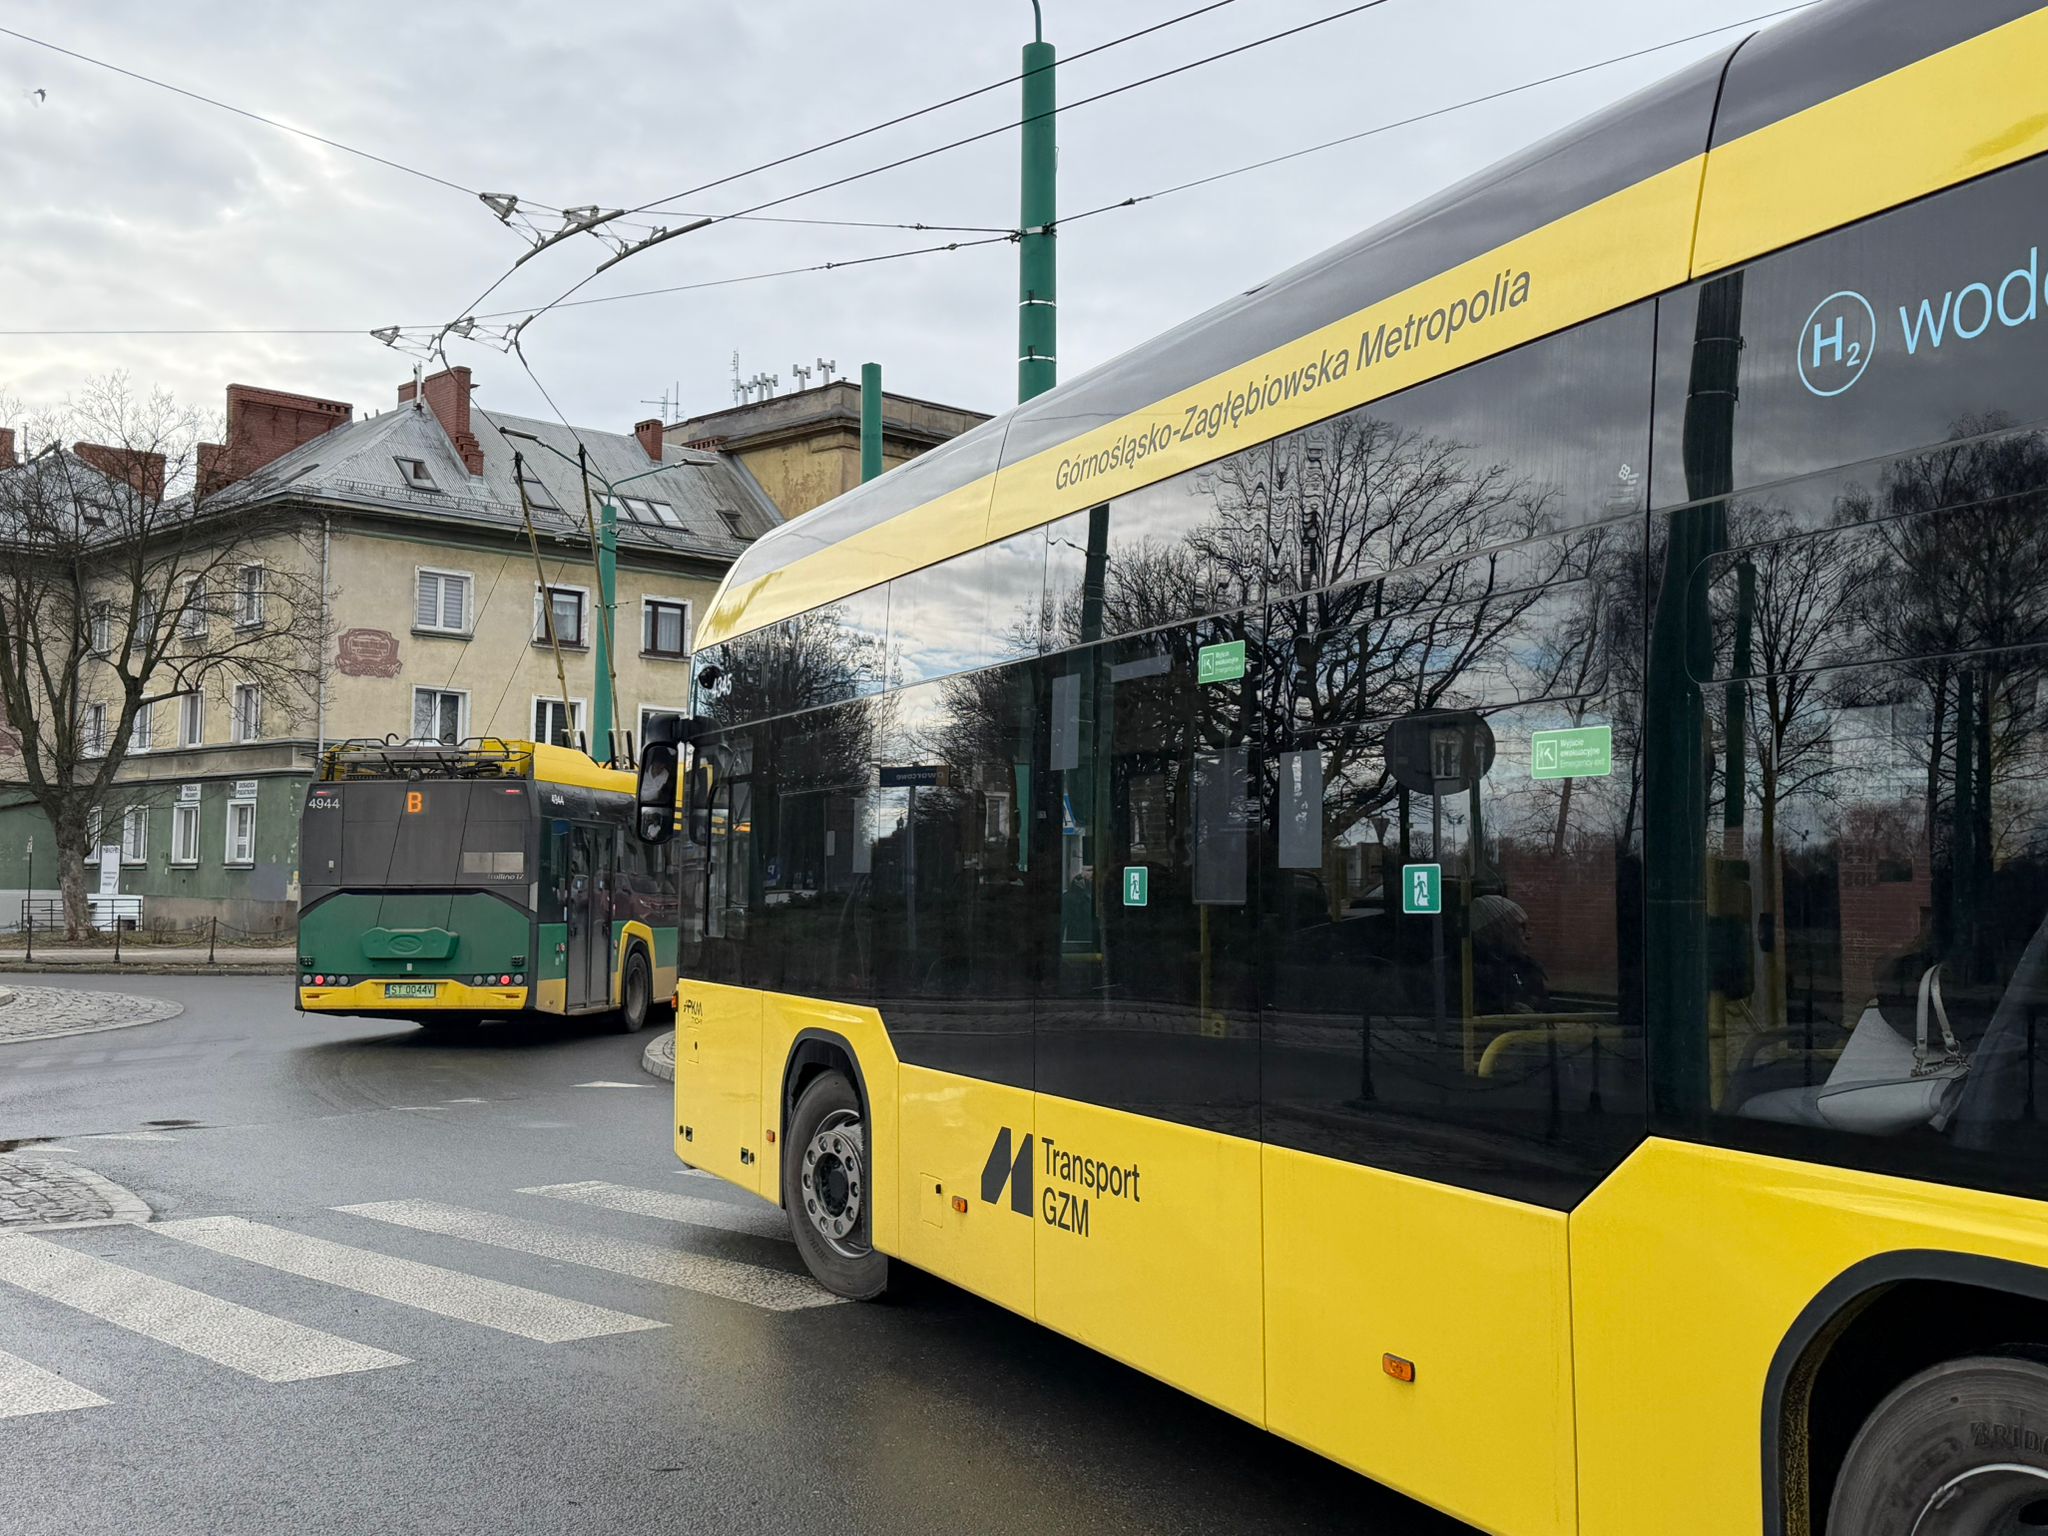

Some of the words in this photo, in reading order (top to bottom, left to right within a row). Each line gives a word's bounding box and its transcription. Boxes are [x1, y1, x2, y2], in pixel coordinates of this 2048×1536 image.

[1898, 246, 2048, 356] wod
[1055, 349, 1350, 490] Górnośląsko-Zagłębiowska
[1355, 268, 1531, 371] Metropolia
[308, 798, 340, 809] 4944
[407, 791, 423, 814] B
[1041, 1136, 1141, 1202] Transport
[1042, 1187, 1089, 1238] GZM
